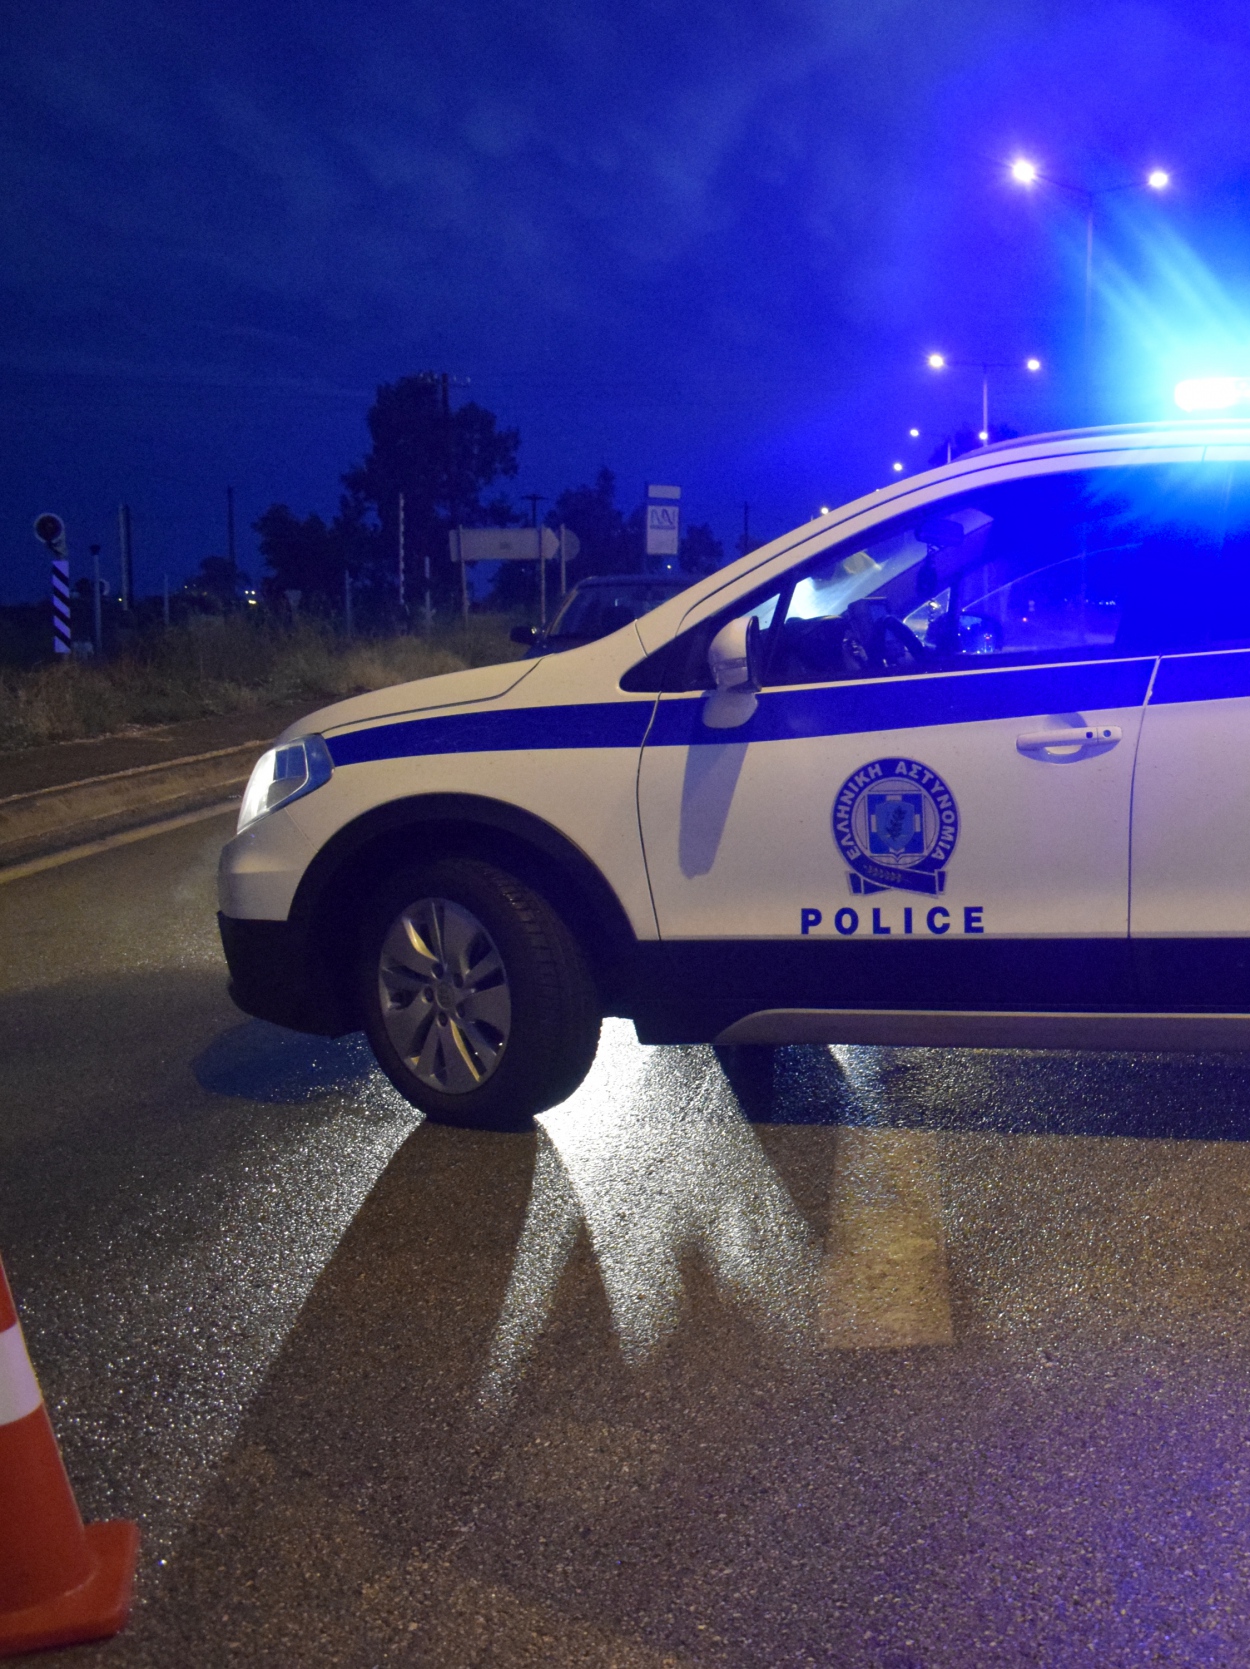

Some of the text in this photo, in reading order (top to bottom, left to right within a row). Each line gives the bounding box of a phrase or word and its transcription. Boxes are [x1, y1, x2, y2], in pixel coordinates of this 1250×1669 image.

[836, 761, 956, 861] ΕΛΛΗΝΙΚΗ ΑΣΤΥΝΟΜΙΑ
[800, 906, 985, 935] POLICE
